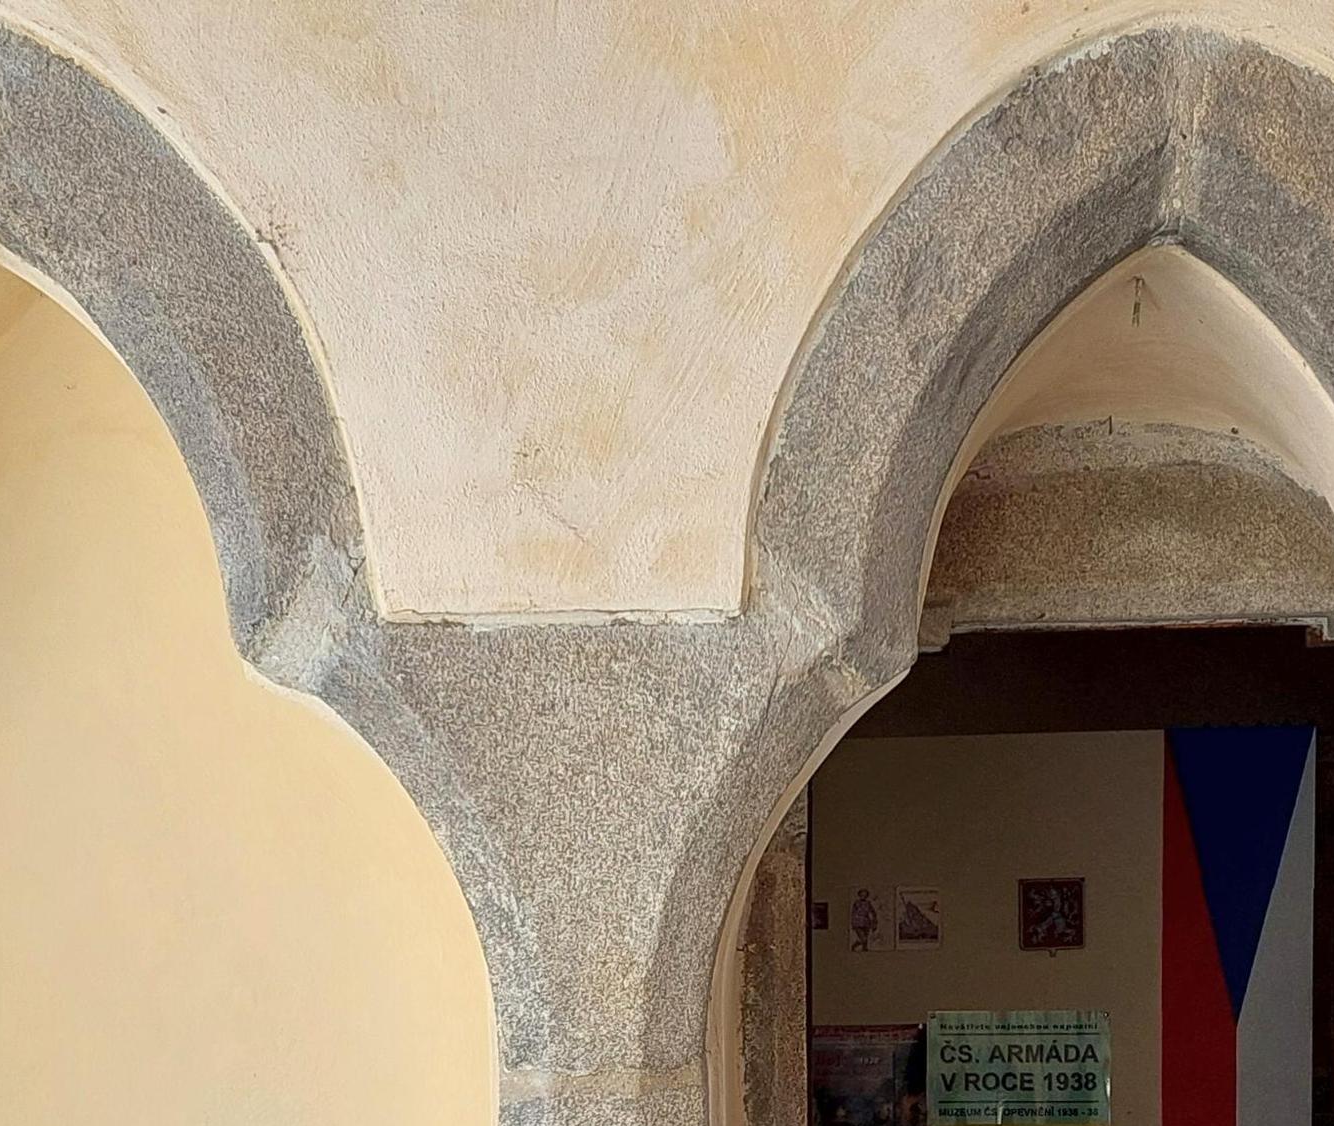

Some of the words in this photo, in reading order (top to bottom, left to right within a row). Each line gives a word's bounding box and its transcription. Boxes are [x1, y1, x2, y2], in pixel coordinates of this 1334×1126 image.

[940, 1040, 979, 1063] ČS.
[989, 1040, 1098, 1063] ARMÁDA
[941, 1073, 956, 1091] V
[965, 1073, 1034, 1091] ROCE
[1044, 1073, 1096, 1091] 1938
